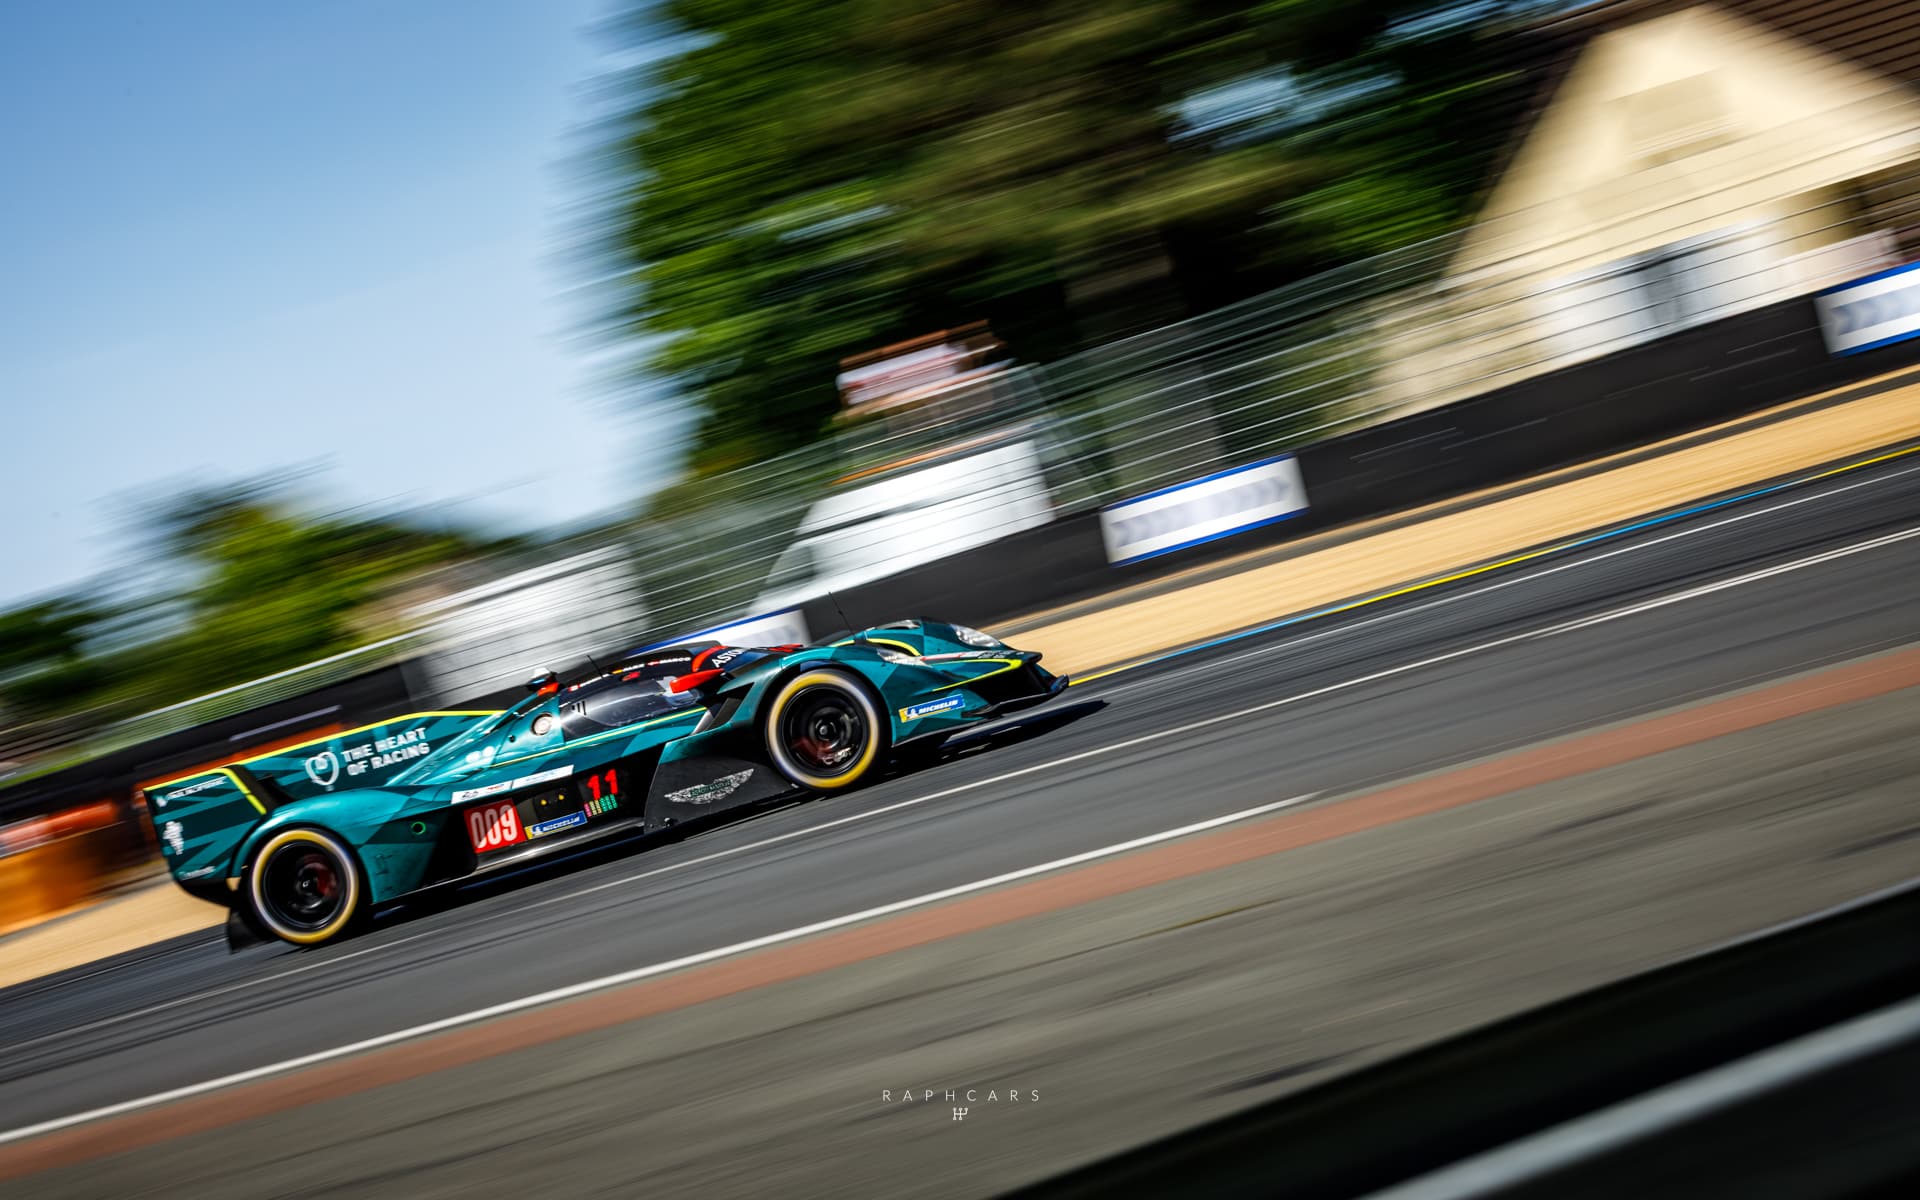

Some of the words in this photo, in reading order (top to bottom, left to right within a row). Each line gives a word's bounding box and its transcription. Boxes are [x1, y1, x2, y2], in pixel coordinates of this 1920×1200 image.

[918, 699, 959, 714] MICHELIN
[341, 743, 374, 762] THE
[374, 727, 426, 752] HEART
[347, 760, 369, 776] OF
[371, 742, 431, 769] RACING
[586, 768, 618, 801] 11
[470, 804, 518, 849] 009
